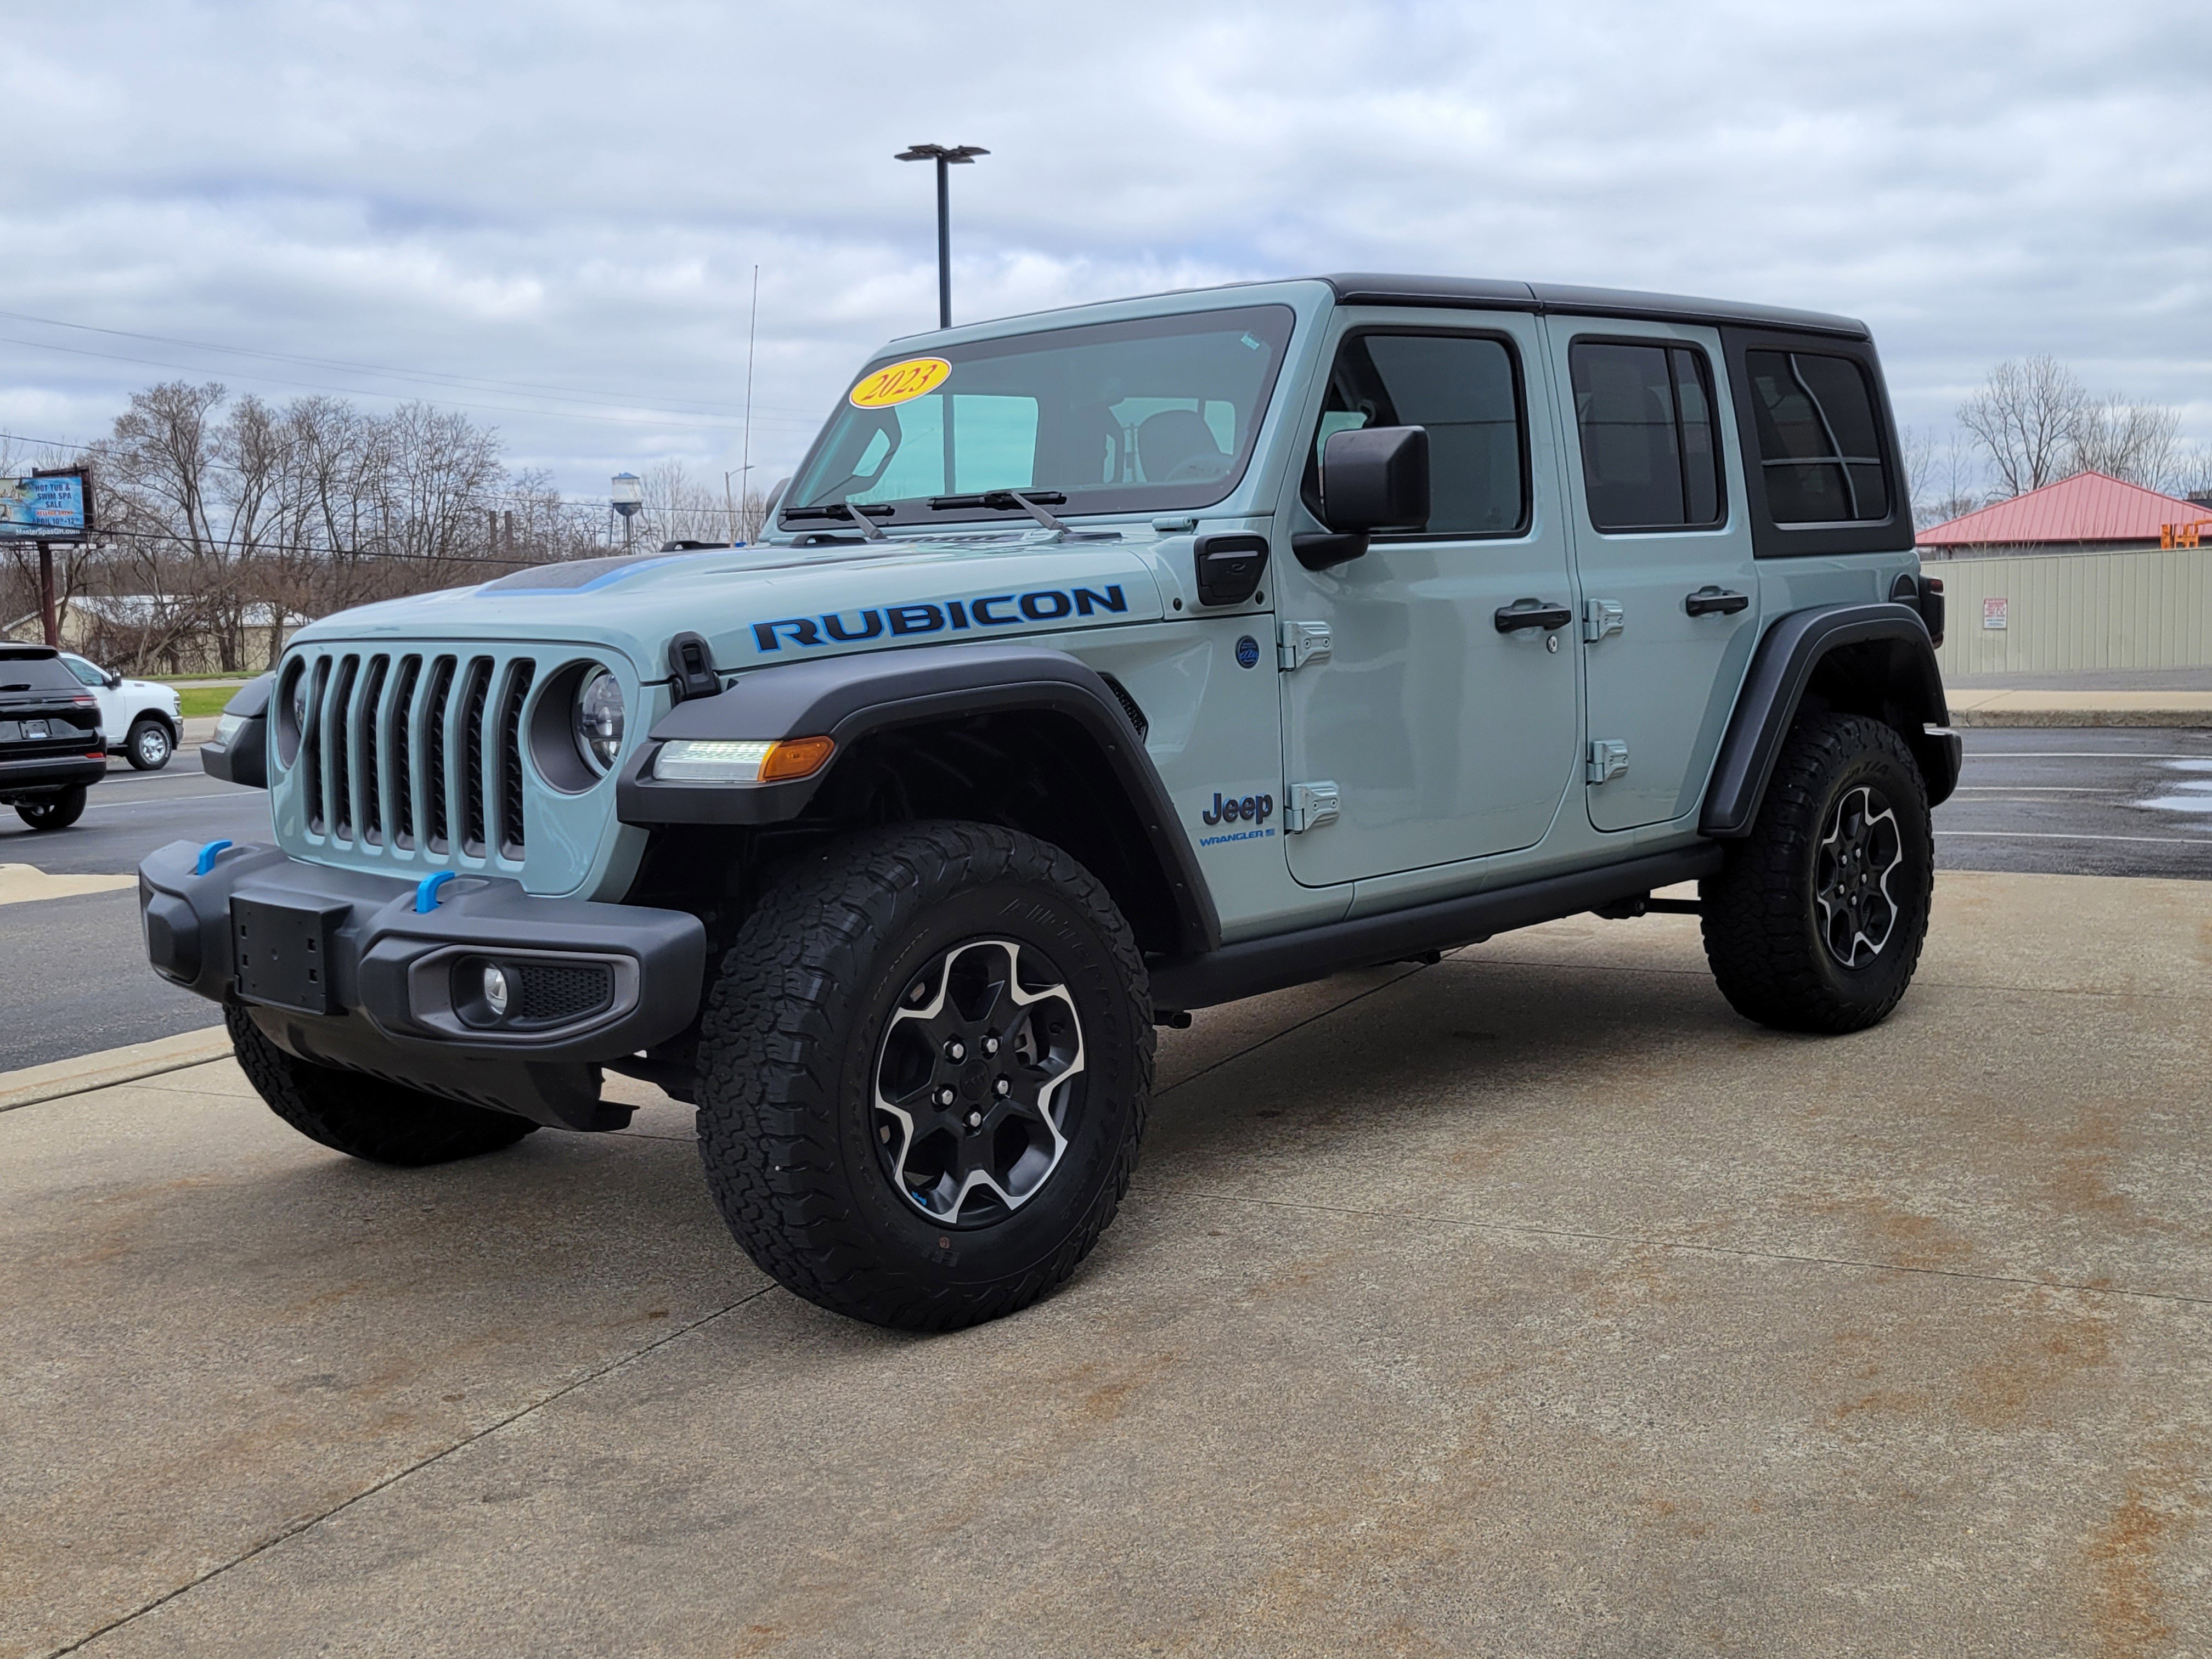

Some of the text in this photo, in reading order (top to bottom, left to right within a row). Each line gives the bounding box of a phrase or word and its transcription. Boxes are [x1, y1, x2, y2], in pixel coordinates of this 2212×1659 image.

[861, 364, 938, 401] 2023
[749, 584, 1128, 653] RUBICON
[1203, 791, 1273, 825] Jeep
[1200, 830, 1263, 847] WRANGLER
